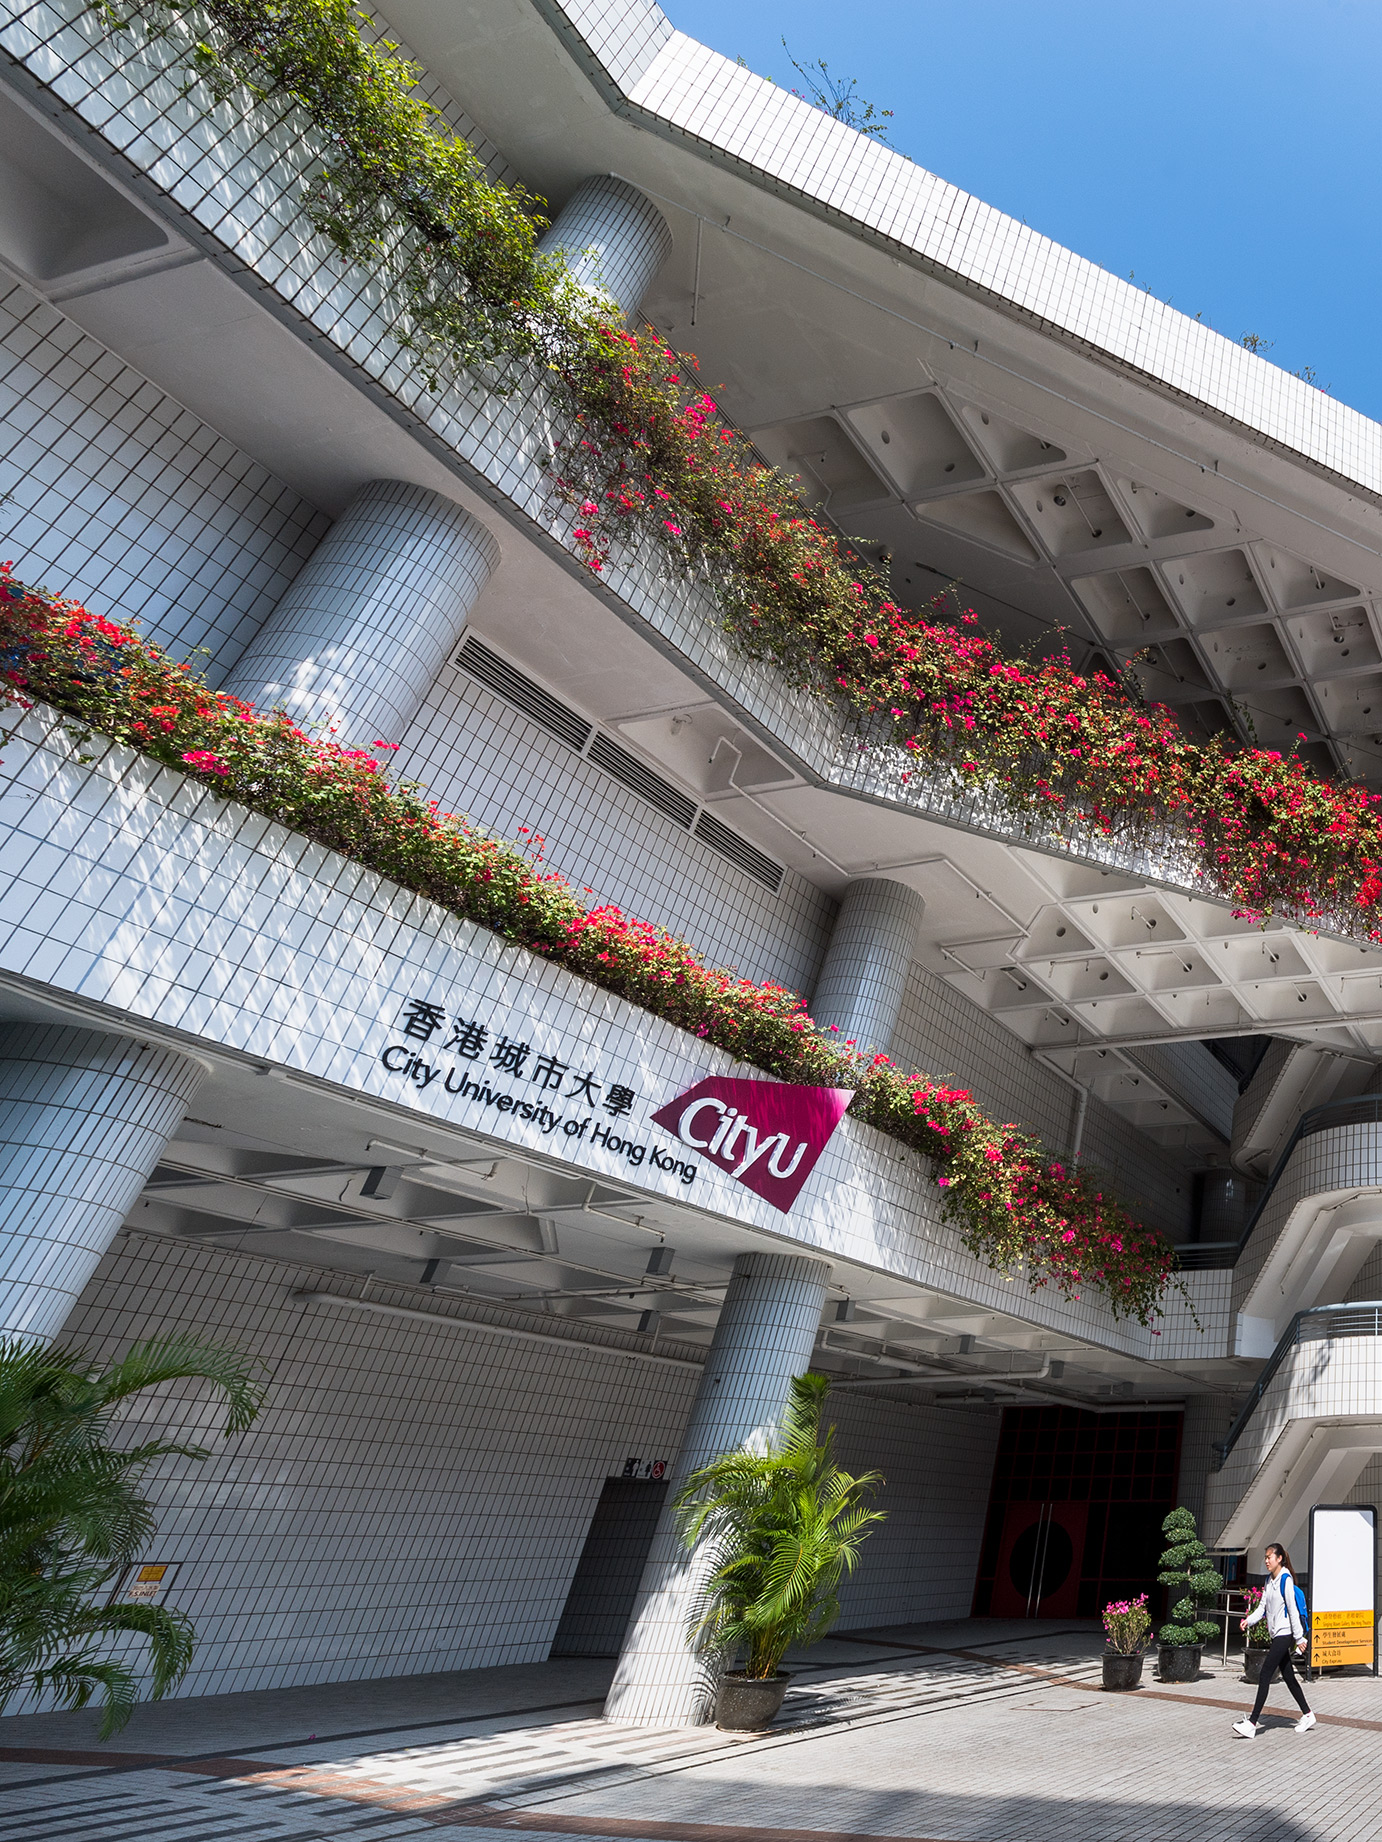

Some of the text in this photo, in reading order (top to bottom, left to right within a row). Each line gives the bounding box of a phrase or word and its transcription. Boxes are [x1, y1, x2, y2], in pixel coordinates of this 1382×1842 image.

[381, 1045, 698, 1185] City University of Hong Kong
[402, 998, 636, 1117] 香港城市大學
